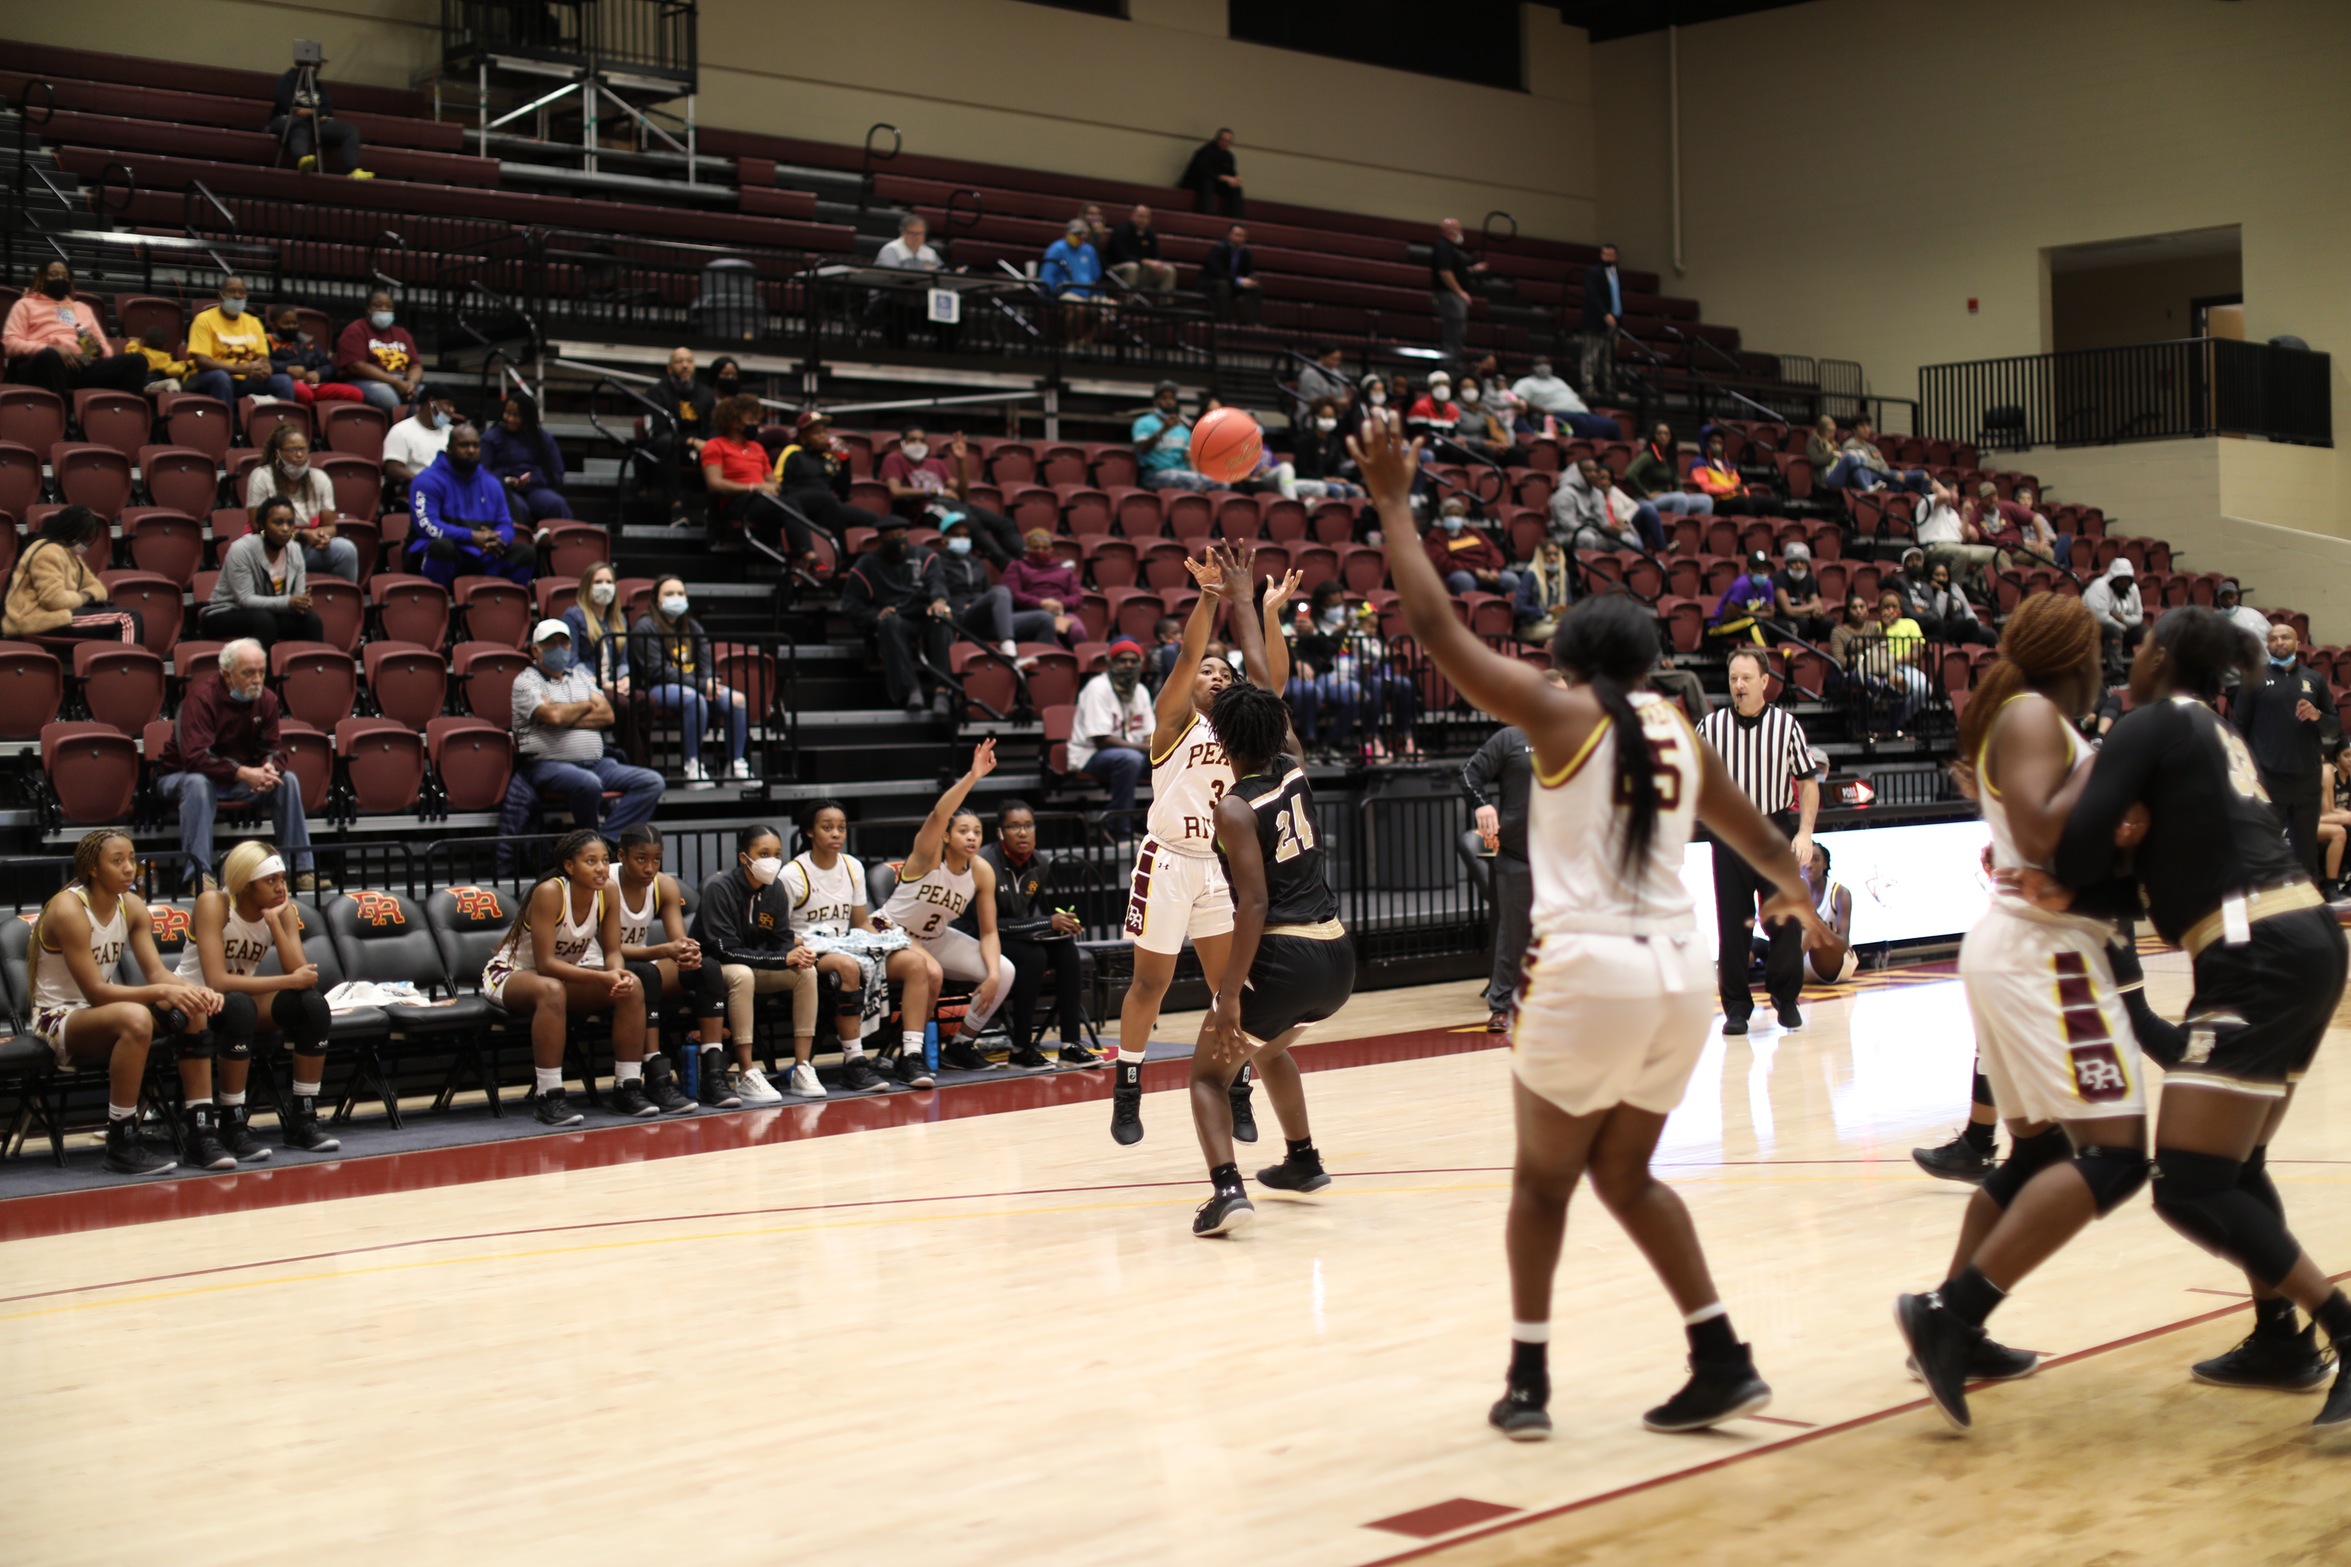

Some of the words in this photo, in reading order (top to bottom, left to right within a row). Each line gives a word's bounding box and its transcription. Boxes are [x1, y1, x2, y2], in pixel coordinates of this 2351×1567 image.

[1186, 742, 1230, 769] PEA
[1275, 793, 1315, 864] 24
[923, 913, 942, 932] 2
